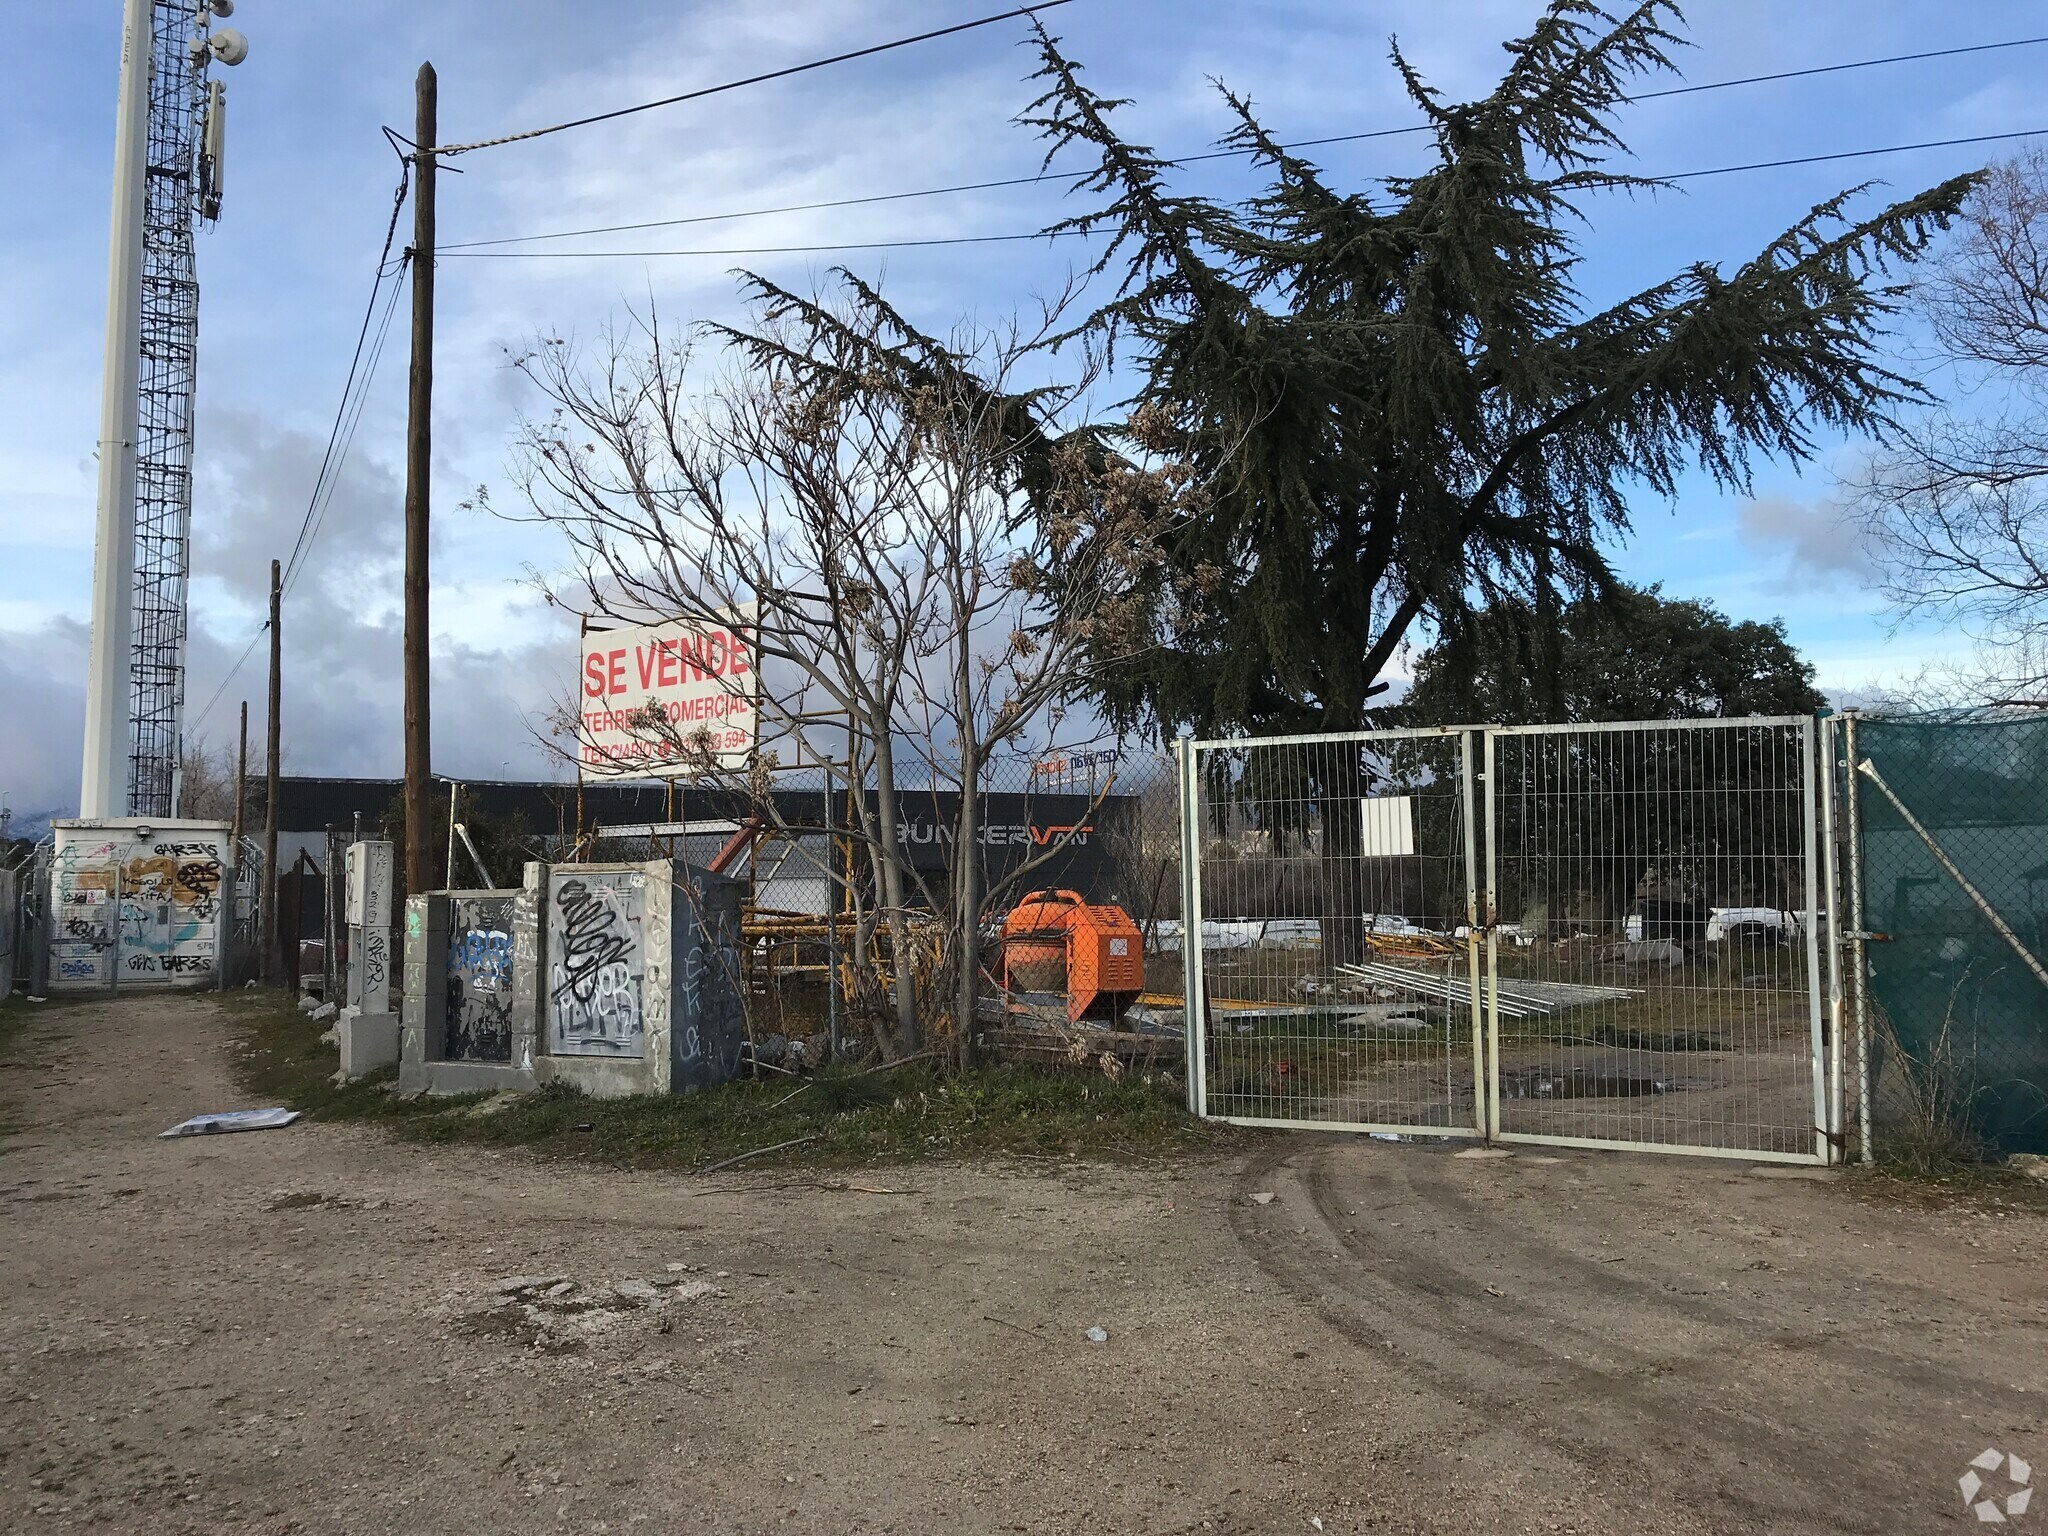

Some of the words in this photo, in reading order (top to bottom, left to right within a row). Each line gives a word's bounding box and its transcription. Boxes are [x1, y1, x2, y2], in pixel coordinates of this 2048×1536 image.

[584, 648, 627, 698] SE
[635, 627, 748, 690] VENDE
[584, 705, 656, 733] TERRE
[724, 730, 746, 749] 594
[894, 823, 1094, 846] BUNERVAN
